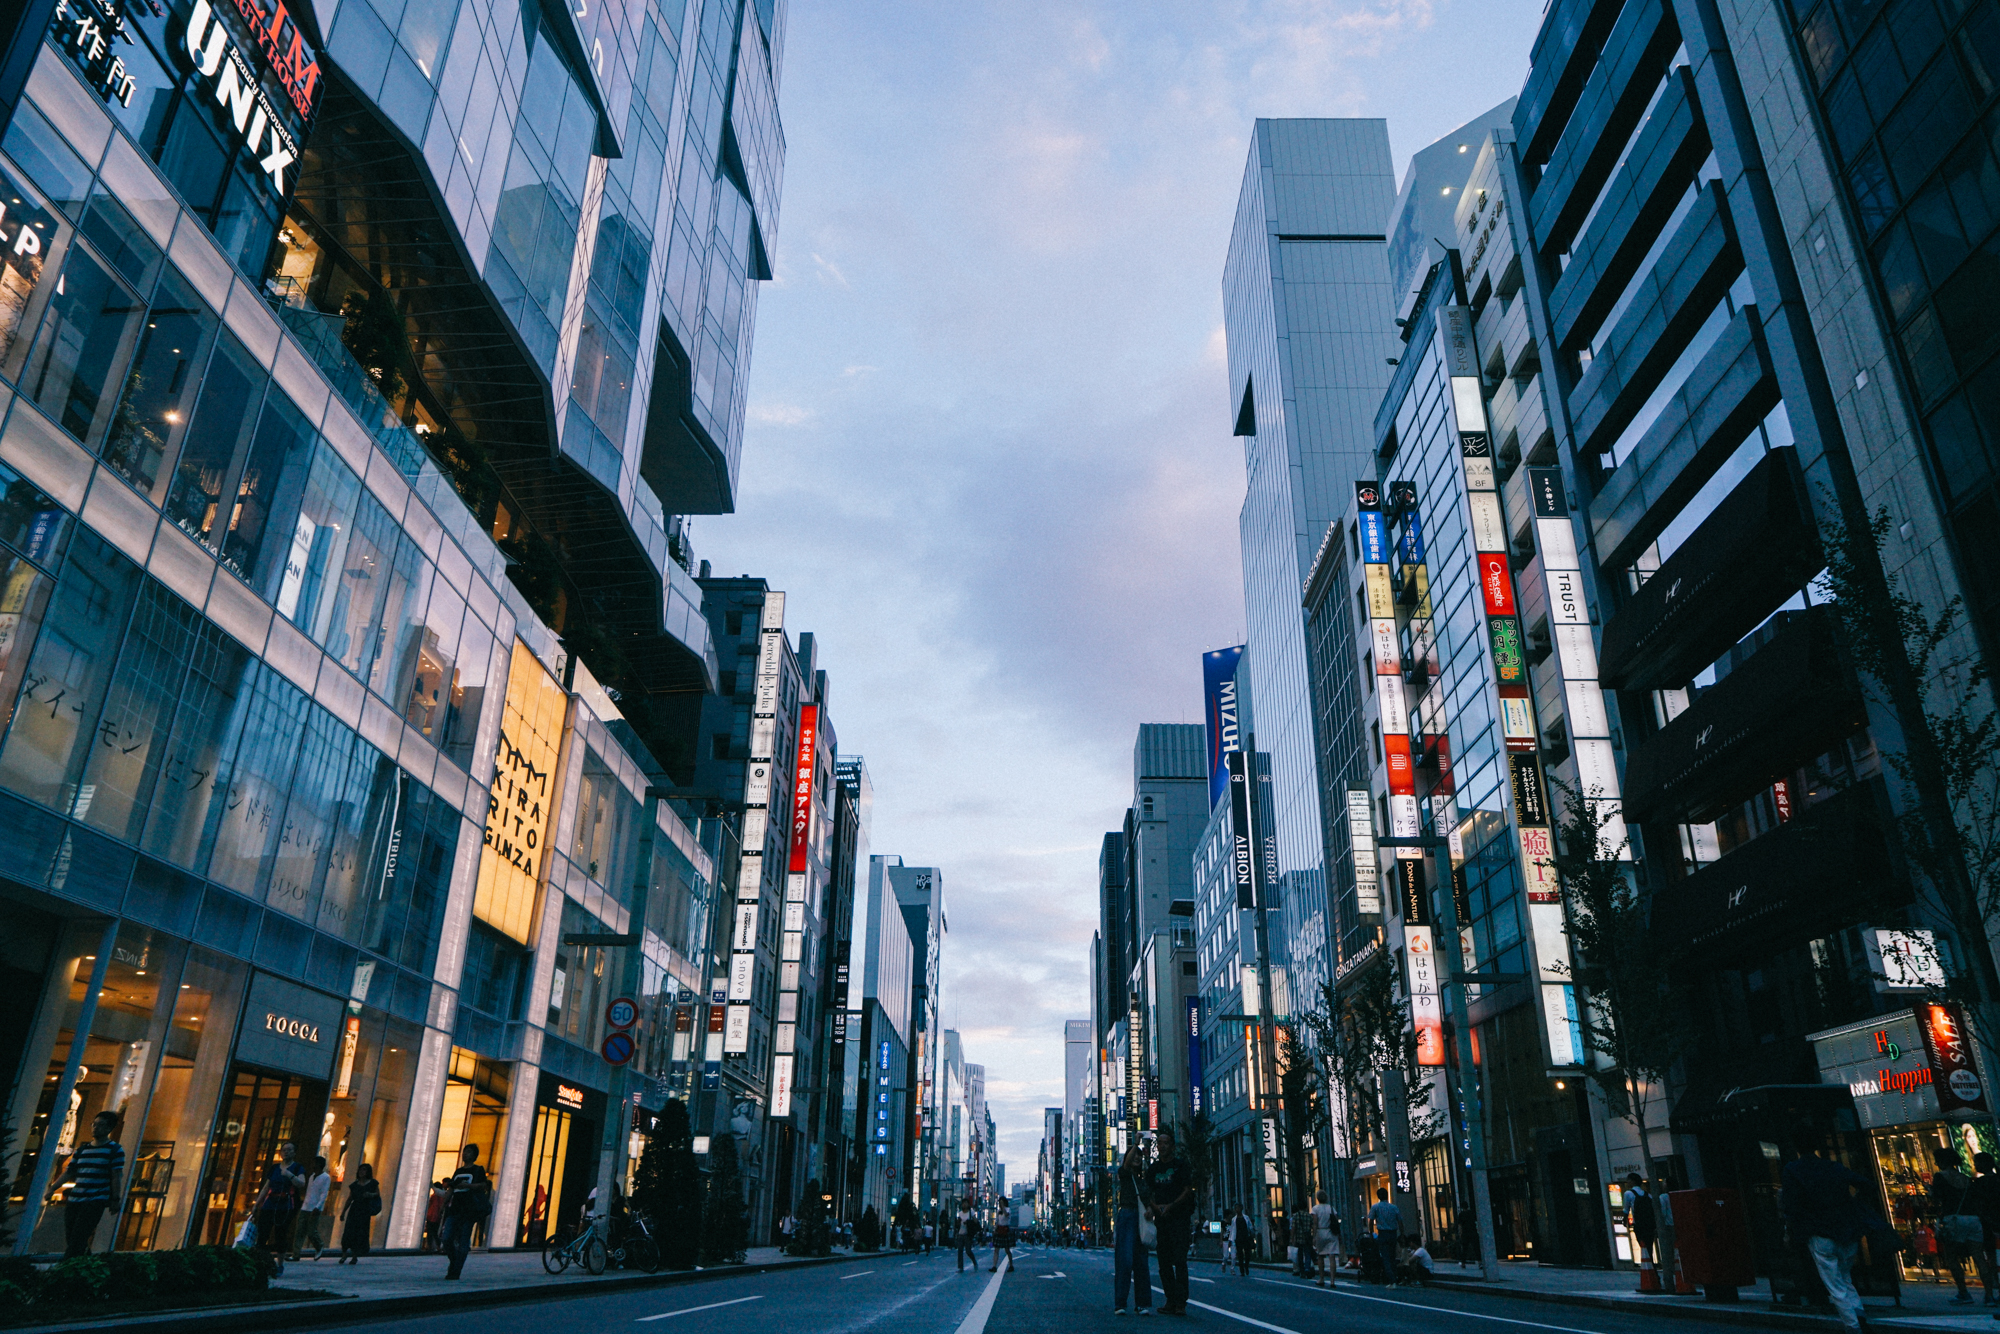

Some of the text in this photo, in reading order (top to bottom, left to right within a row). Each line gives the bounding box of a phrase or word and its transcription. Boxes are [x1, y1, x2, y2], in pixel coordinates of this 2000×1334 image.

[186, 0, 294, 196] UNIX
[229, 46, 299, 159] Beauty Innovation
[267, 43, 310, 122] HOUSE
[1462, 436, 1487, 455] 彩
[1466, 464, 1492, 472] AYA
[1474, 479, 1487, 487] 8F
[1366, 514, 1381, 561] 東京銀座歯科
[1558, 573, 1577, 621] TRUST
[1381, 635, 1393, 665] はせがわ
[1504, 619, 1521, 666] マッサージ
[1500, 667, 1519, 680] 5F
[492, 765, 541, 823] KIRA
[795, 729, 812, 846] 中国名菜 銀座アスター
[1508, 755, 1523, 826] Nail School Salon
[1527, 767, 1541, 822] エンパイア・ニューヨーク
[487, 795, 537, 850] RITO
[484, 826, 532, 876] GINZA
[1235, 834, 1250, 885] ALBION
[1410, 894, 1419, 923] NATURE
[1536, 893, 1550, 901] 2F
[1335, 939, 1376, 980] GINZA TANAKA
[1415, 956, 1432, 1007] はせがわ
[265, 1014, 319, 1043] TOCCA
[612, 1006, 632, 1021] 50
[1551, 1003, 1567, 1061] MIO STILE
[1926, 1017, 1943, 1071] Happiness
[1939, 1014, 1967, 1066] SALE
[877, 1079, 889, 1155] MELSA
[1396, 1170, 1409, 1179] 17
[1397, 1178, 1410, 1188] 43
